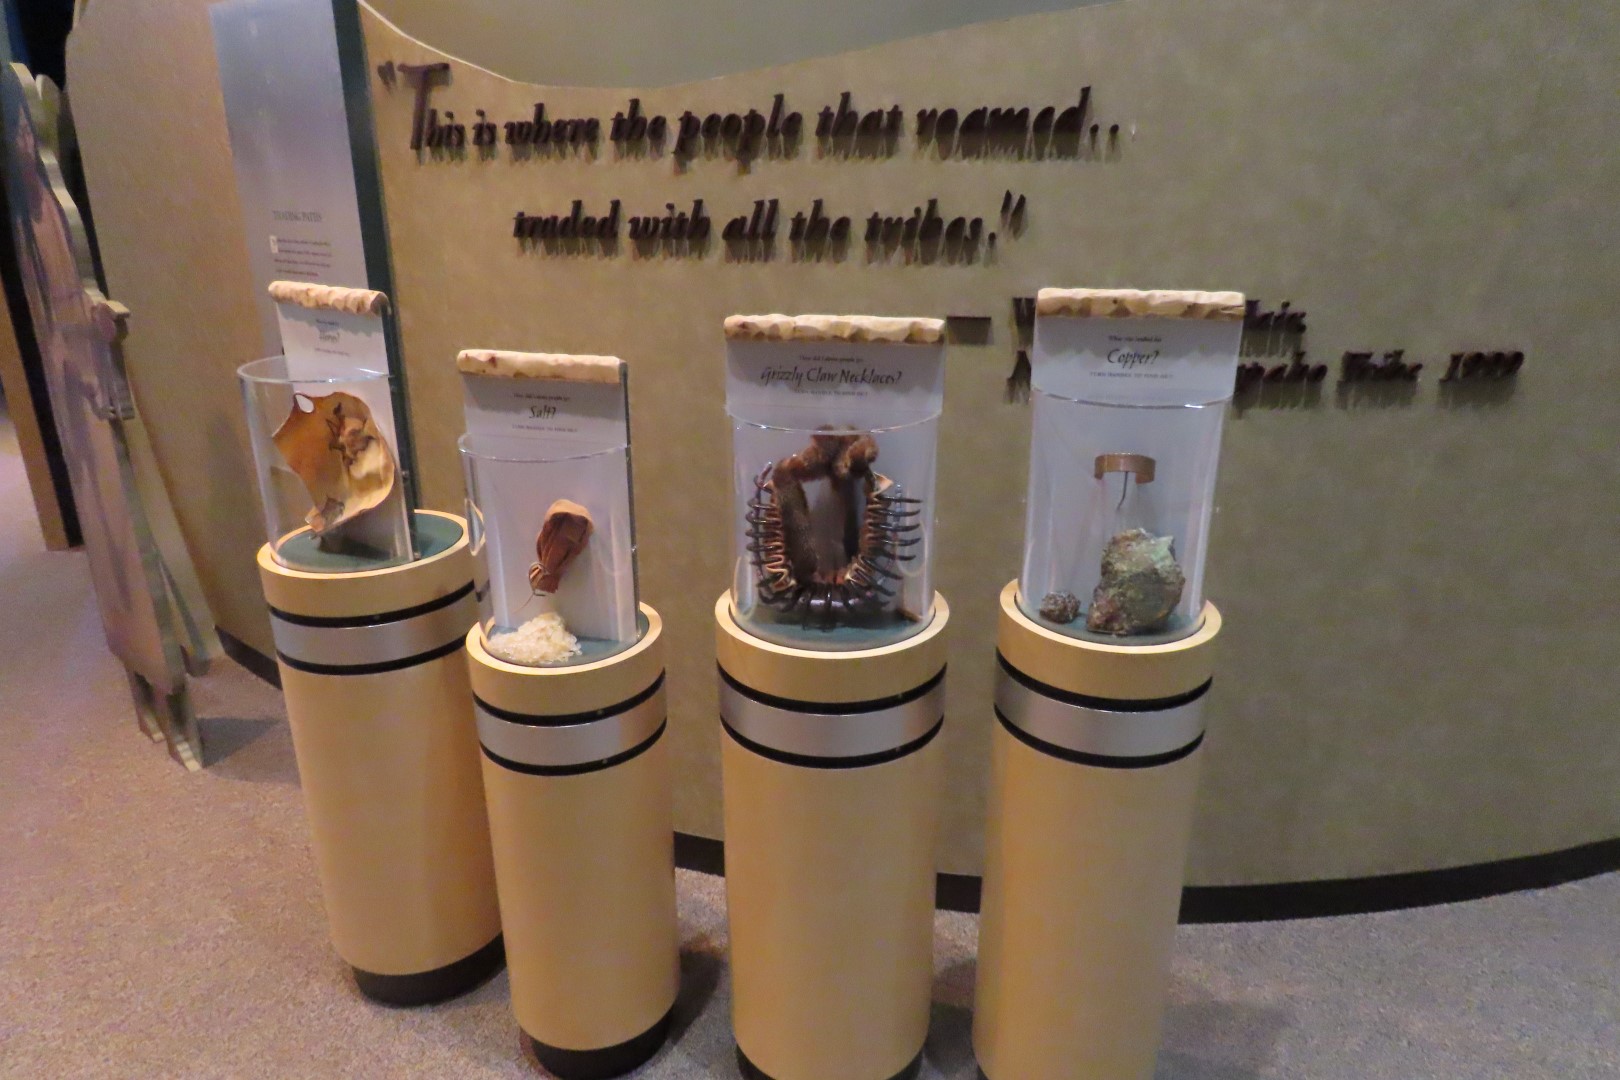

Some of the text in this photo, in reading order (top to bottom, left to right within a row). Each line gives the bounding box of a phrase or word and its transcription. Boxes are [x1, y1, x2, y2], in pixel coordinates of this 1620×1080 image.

[474, 109, 497, 149] is
[504, 102, 602, 150] where
[611, 98, 668, 146] the
[673, 93, 804, 164] people
[815, 91, 904, 144] that
[513, 199, 621, 244] traded
[629, 199, 712, 246] with
[722, 199, 780, 248] all
[789, 199, 853, 248] the
[1107, 348, 1160, 369] Copper?
[806, 366, 838, 383] Claw
[839, 368, 903, 386] Necklaces?
[529, 404, 557, 420] Salt?
